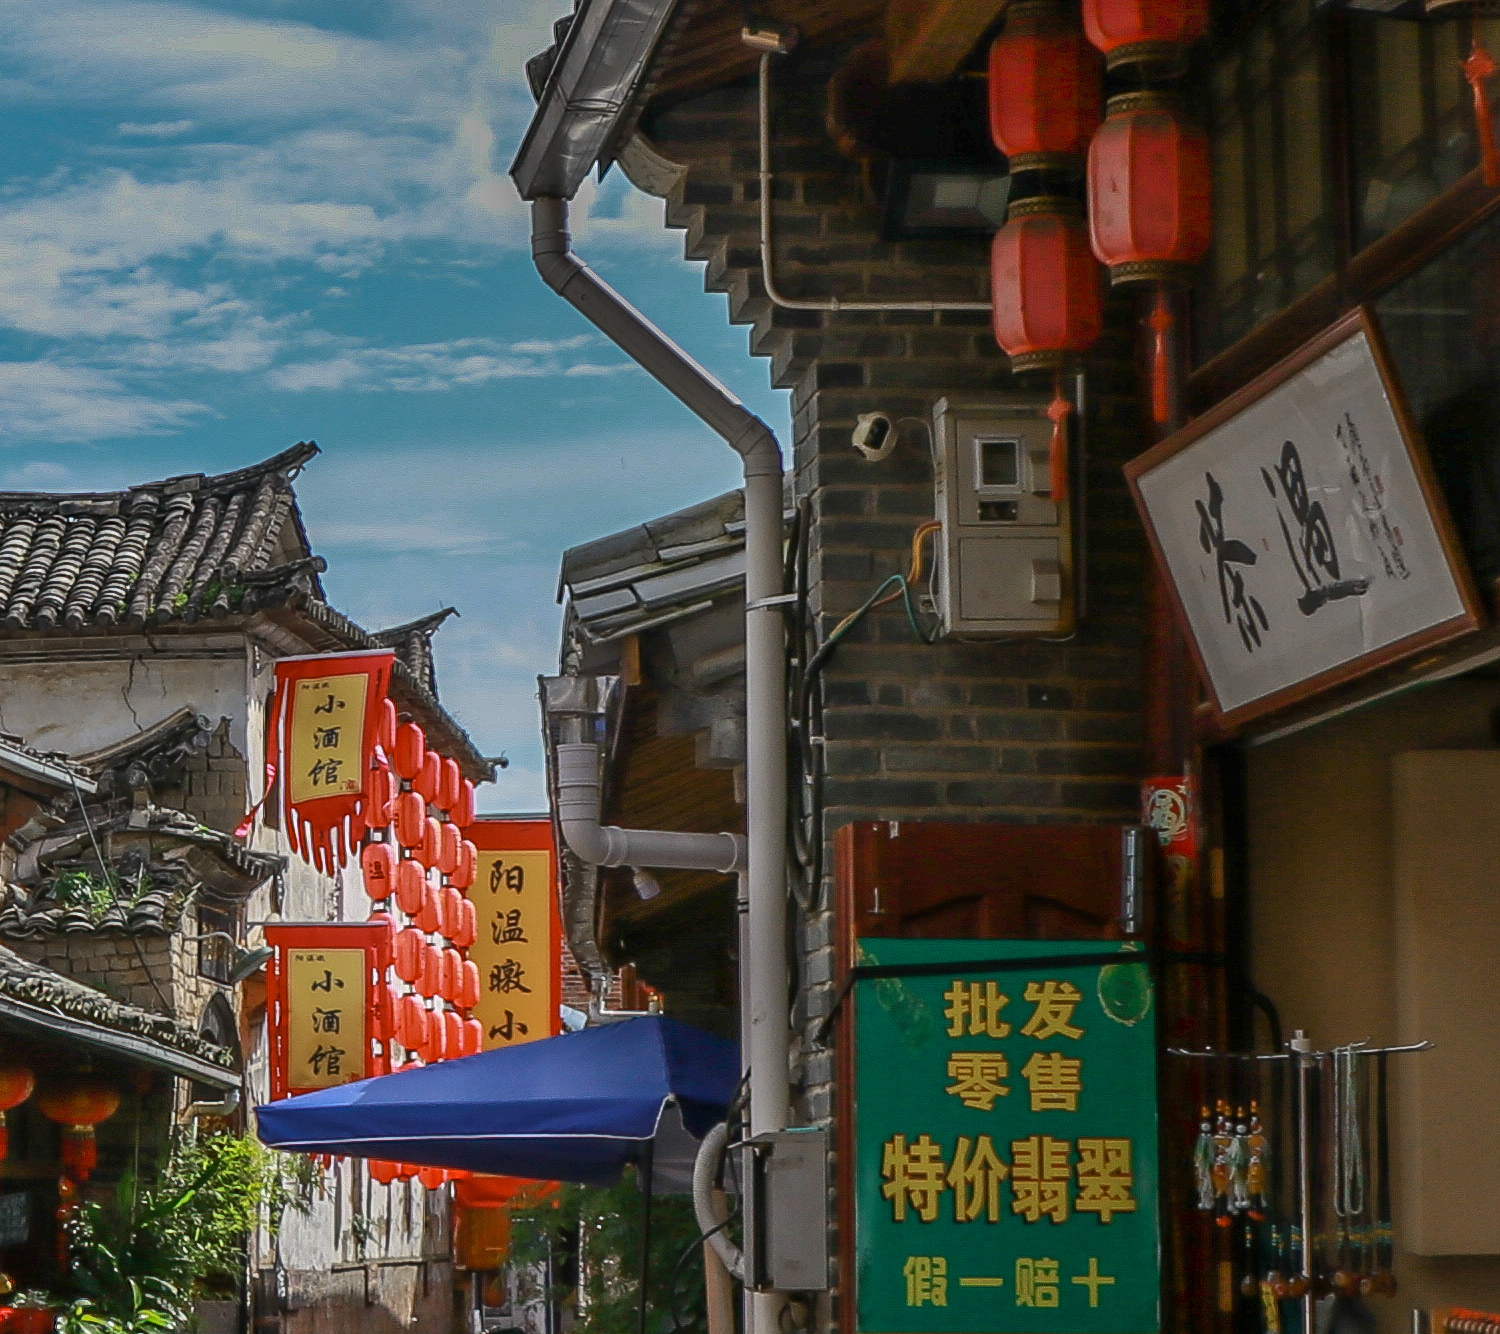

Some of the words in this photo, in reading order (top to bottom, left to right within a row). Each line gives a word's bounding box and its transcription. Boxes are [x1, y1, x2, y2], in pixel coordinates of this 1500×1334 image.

[307, 694, 346, 787] 小酒馆
[308, 969, 346, 1076] 小酒馆
[943, 979, 1085, 1041] 批发
[944, 1051, 1084, 1113] 零售
[881, 1134, 1138, 1225] 特价翡翠
[903, 1256, 1116, 1309] 假一赔十
